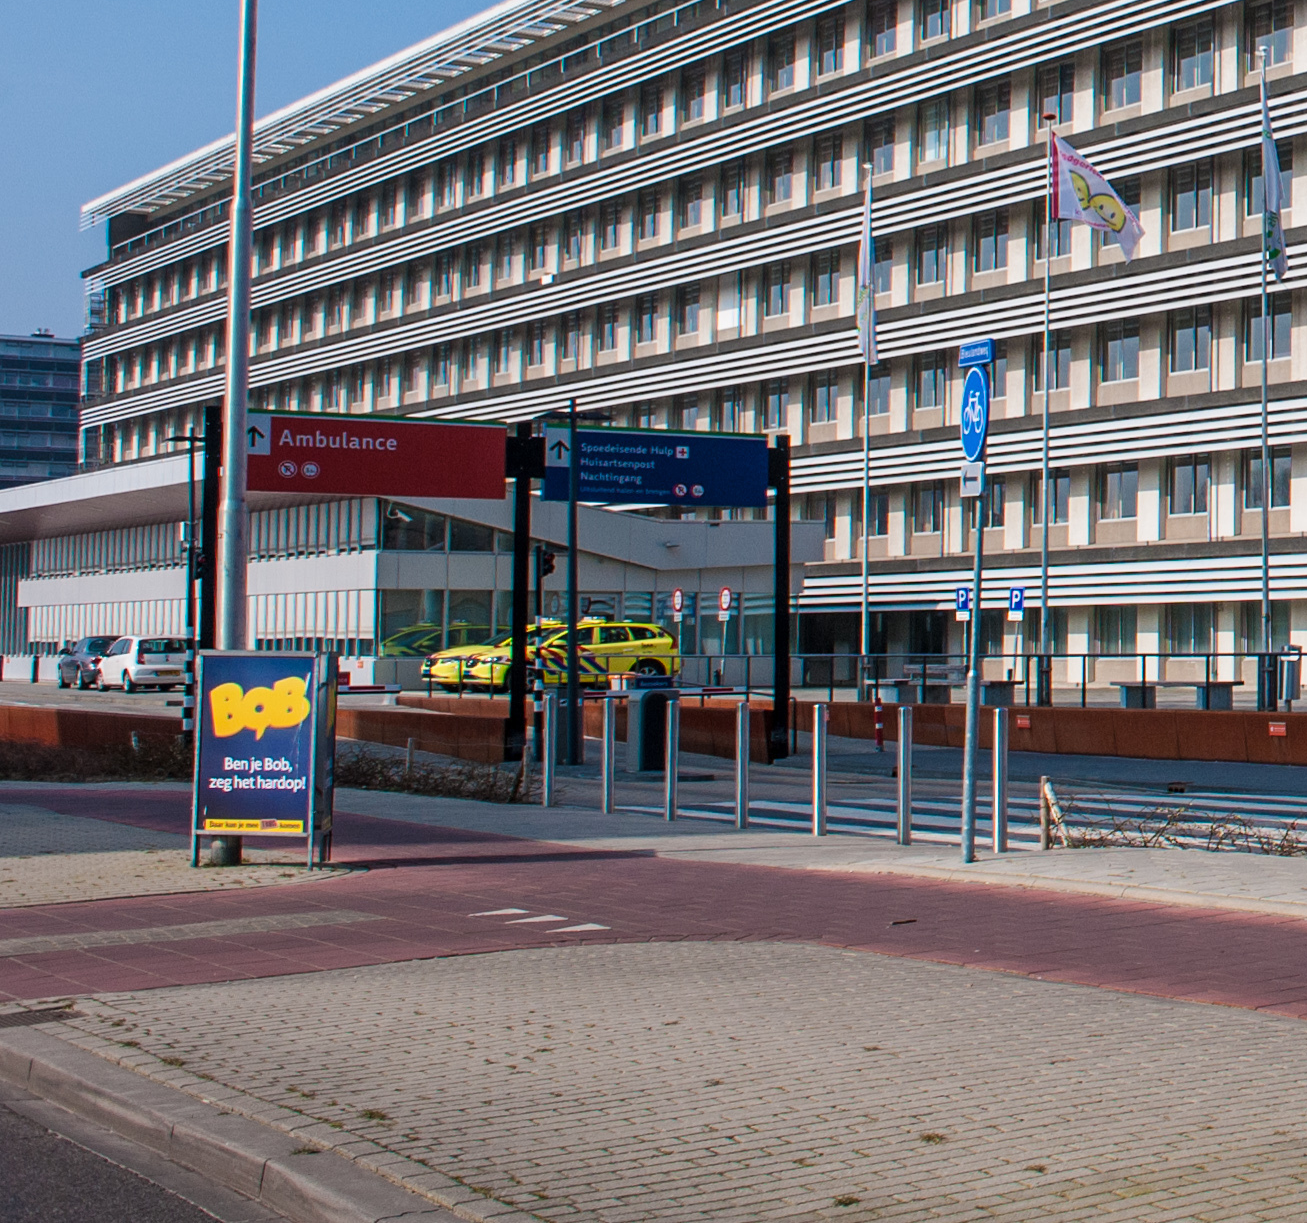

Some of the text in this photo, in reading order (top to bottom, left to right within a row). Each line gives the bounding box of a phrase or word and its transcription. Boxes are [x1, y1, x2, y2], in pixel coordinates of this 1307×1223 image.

[279, 428, 398, 451] Ambulance
[580, 442, 674, 457] Spoedeisende Hulp
[580, 457, 655, 469] Huisartsenpost
[580, 472, 643, 485] Nachtingang
[958, 589, 967, 608] P
[1011, 589, 1022, 609] P
[209, 676, 311, 741] BOB
[224, 756, 293, 774] Ben je Bob,
[208, 774, 307, 794] zeg het hardop!
